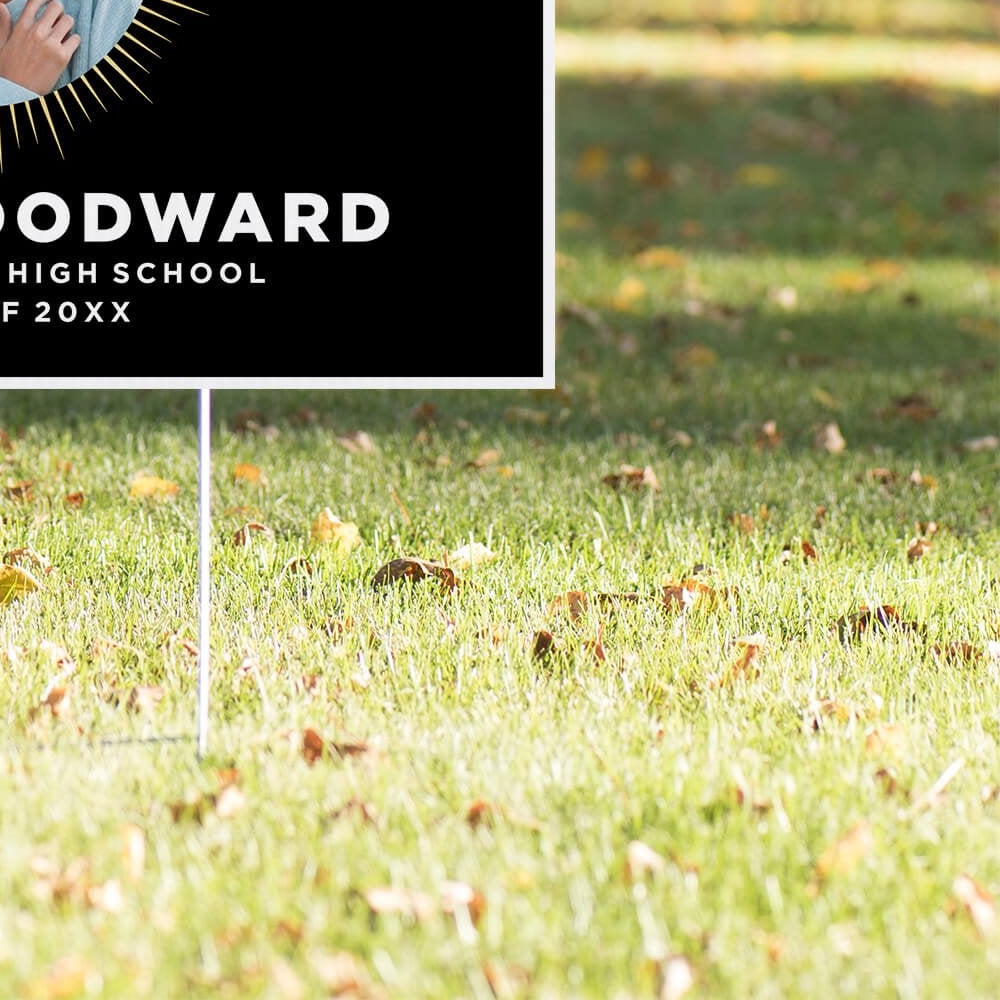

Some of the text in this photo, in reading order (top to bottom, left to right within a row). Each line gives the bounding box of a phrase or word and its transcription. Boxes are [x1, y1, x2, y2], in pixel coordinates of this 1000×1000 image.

[8, 262, 97, 284] HIGH
[112, 262, 266, 284] SCHOOL
[34, 301, 131, 323] 20XX
